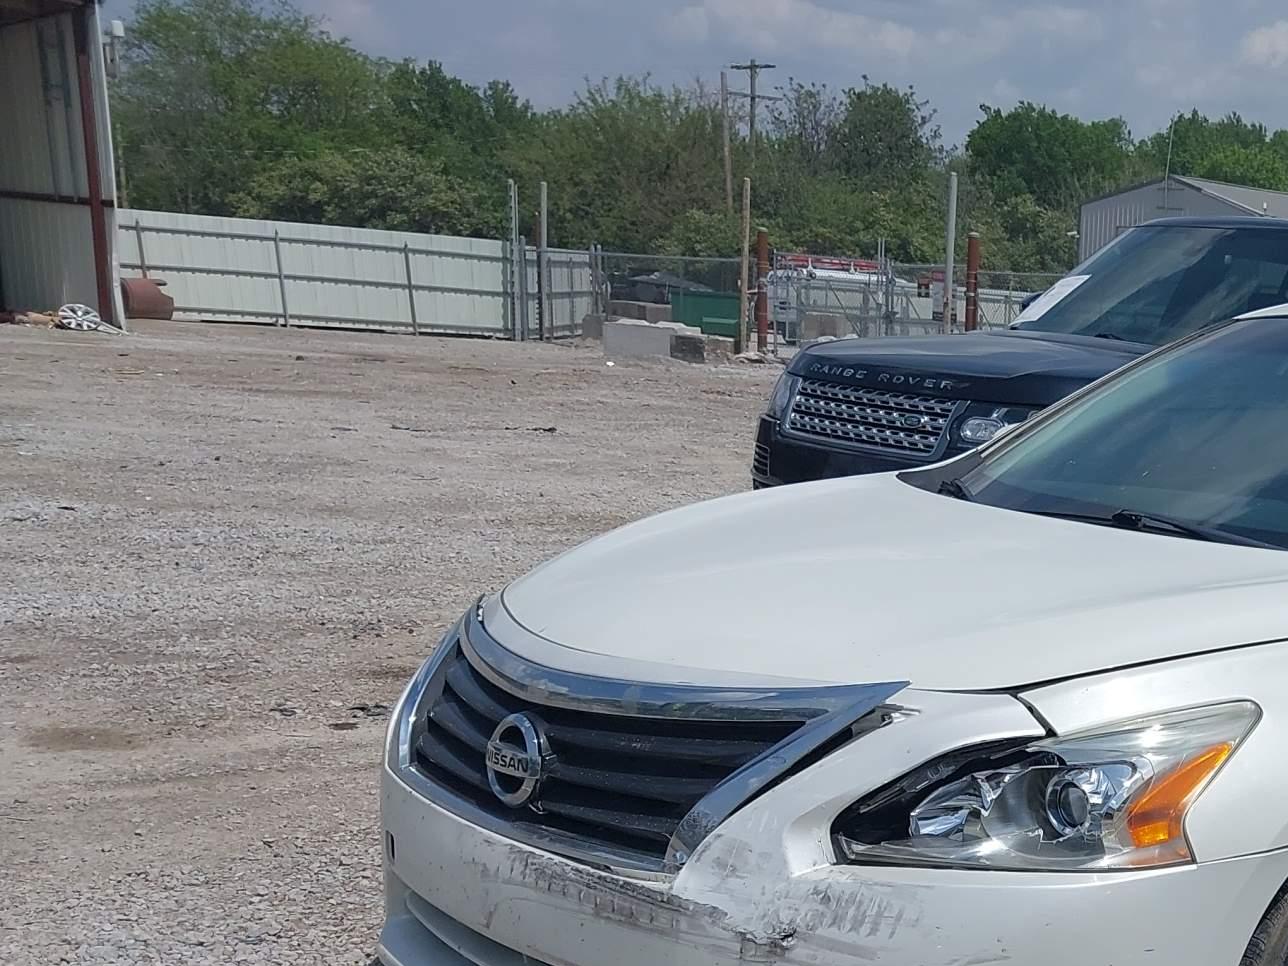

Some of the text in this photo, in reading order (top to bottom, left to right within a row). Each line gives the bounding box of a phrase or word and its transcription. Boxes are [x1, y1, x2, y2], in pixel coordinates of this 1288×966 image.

[810, 362, 953, 390] RANGE ROVER
[487, 750, 528, 773] NISSAN
